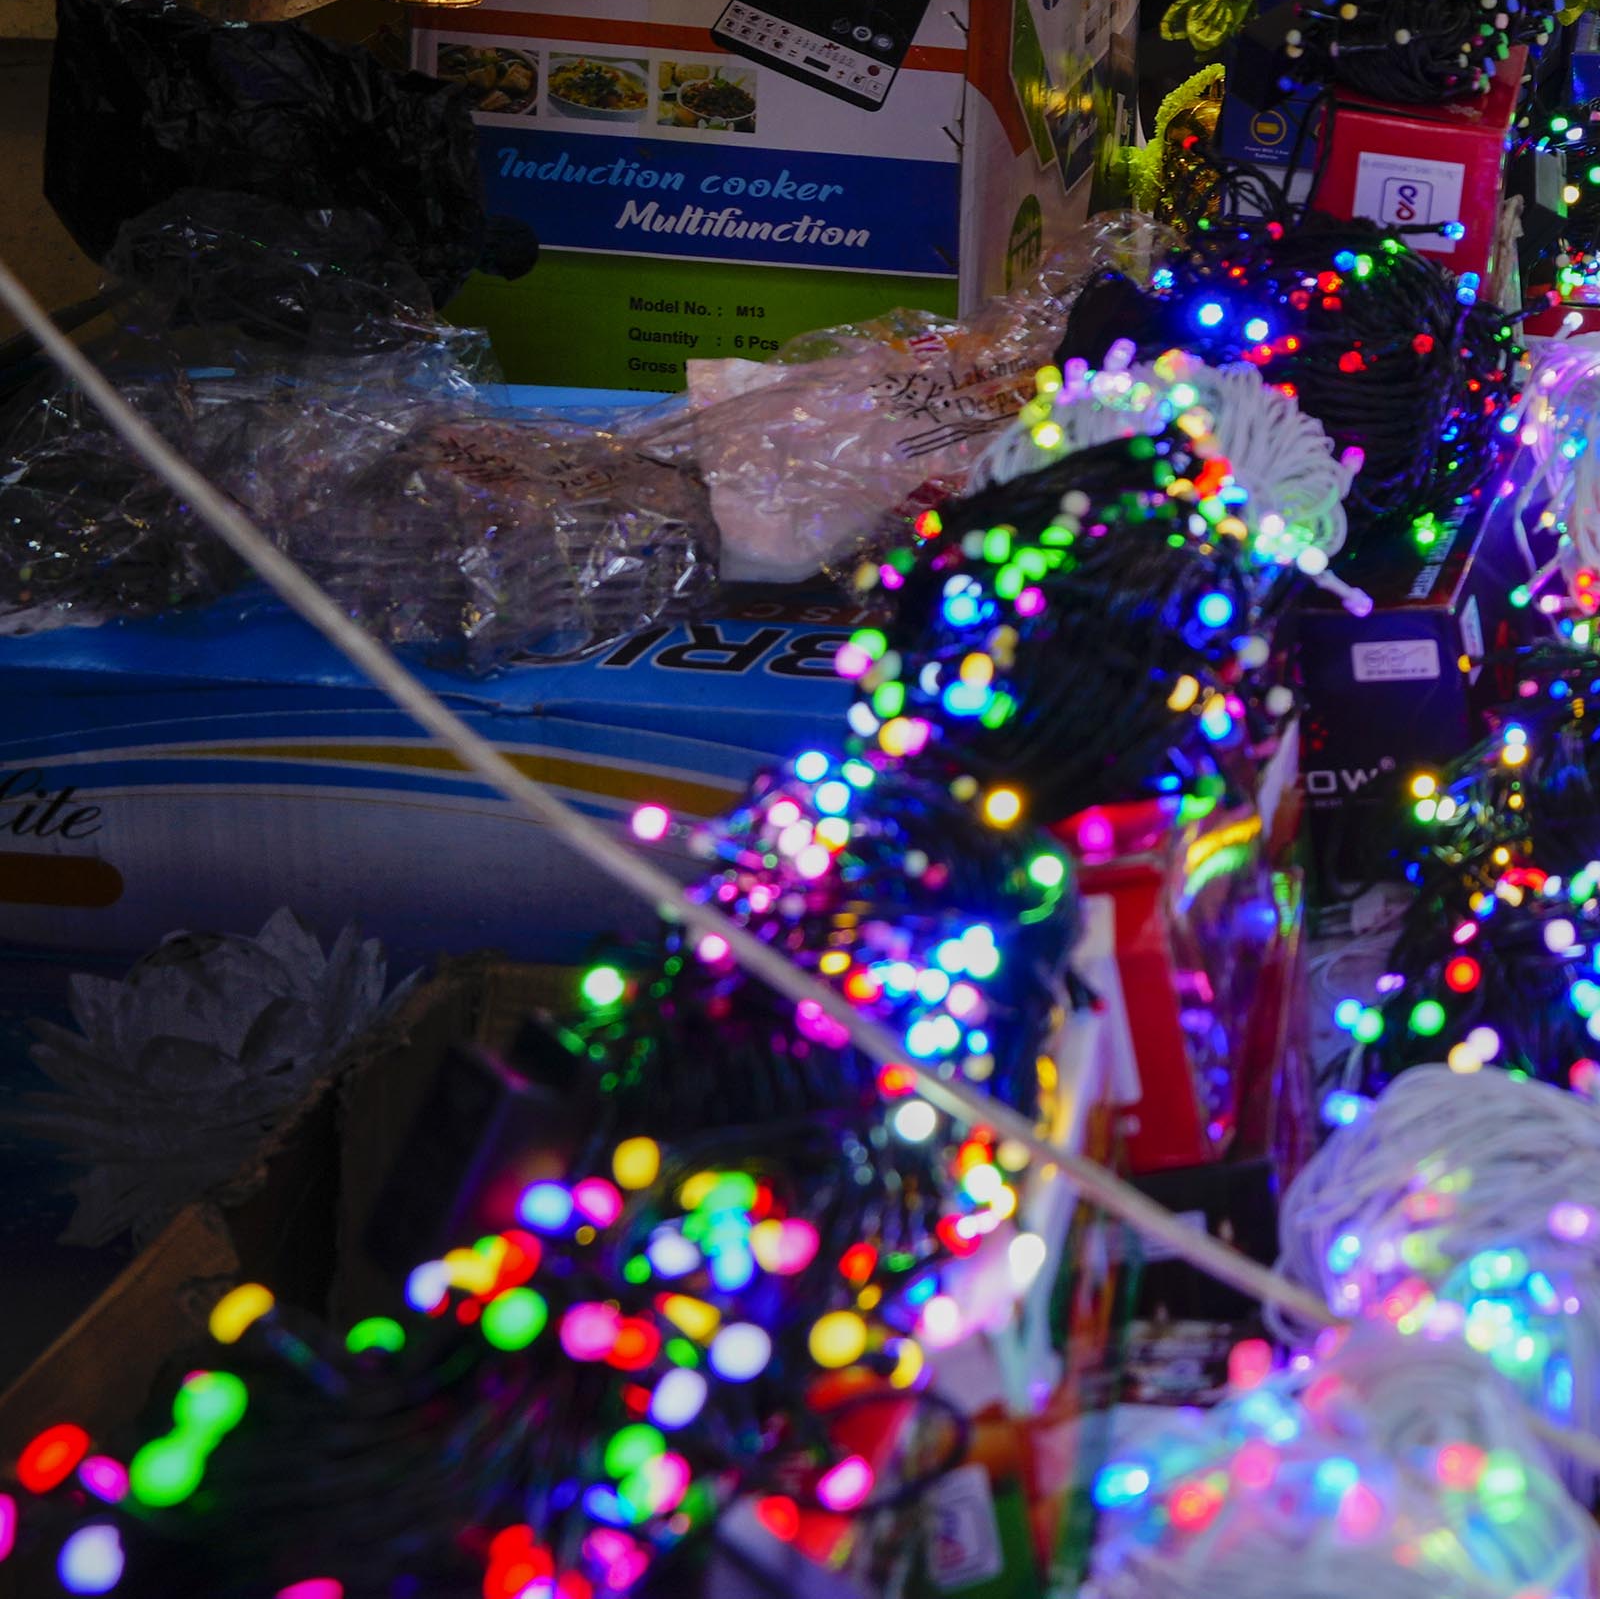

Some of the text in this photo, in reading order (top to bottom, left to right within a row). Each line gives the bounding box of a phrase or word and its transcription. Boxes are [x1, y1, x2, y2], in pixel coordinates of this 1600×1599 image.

[497, 147, 844, 203] Induction cooker
[615, 199, 871, 249] Multifunction
[628, 297, 679, 315] Model
[683, 301, 711, 317] No.
[736, 305, 766, 319] M13
[628, 328, 699, 350] Quantity
[734, 336, 744, 350] 6
[748, 337, 780, 351] Pcs
[628, 356, 678, 375] Gross
